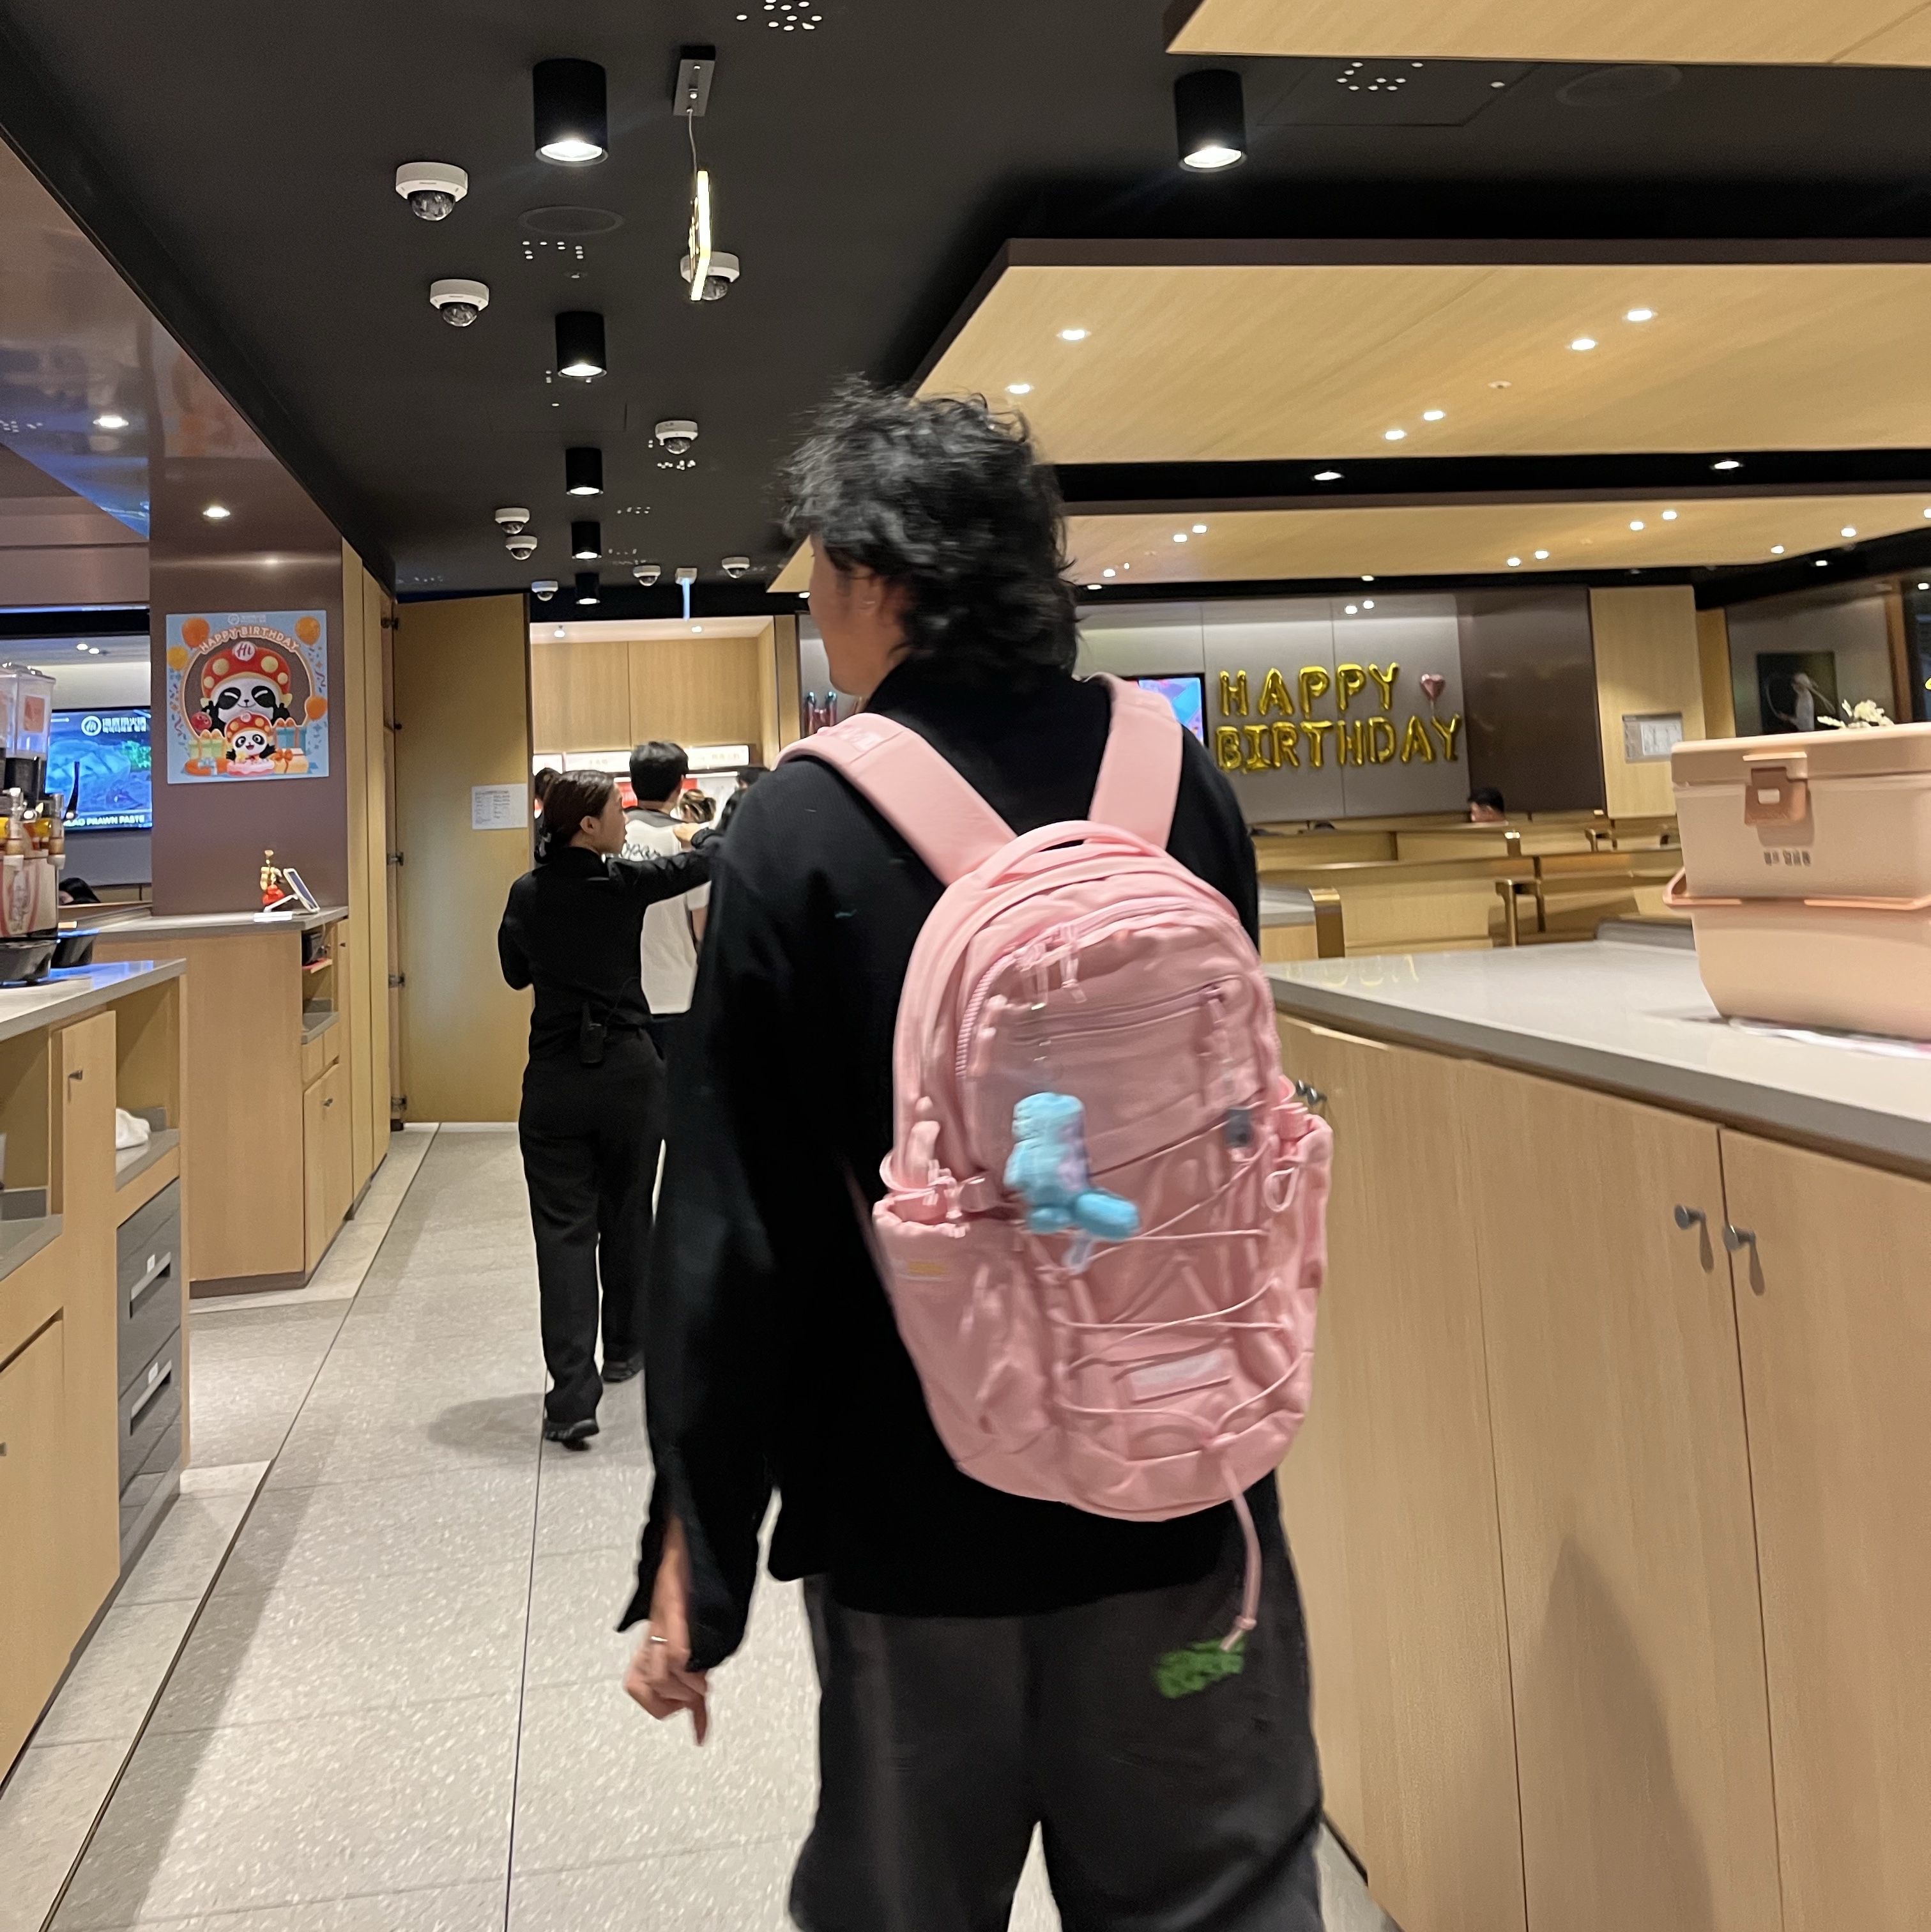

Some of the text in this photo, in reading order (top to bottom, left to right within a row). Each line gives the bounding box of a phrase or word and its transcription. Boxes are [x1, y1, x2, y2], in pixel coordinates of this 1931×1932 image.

[199, 626, 300, 652] HAPPY BIRTHDAY
[1219, 662, 1400, 718] HAPPY
[1216, 713, 1462, 774] BIRTHDAY
